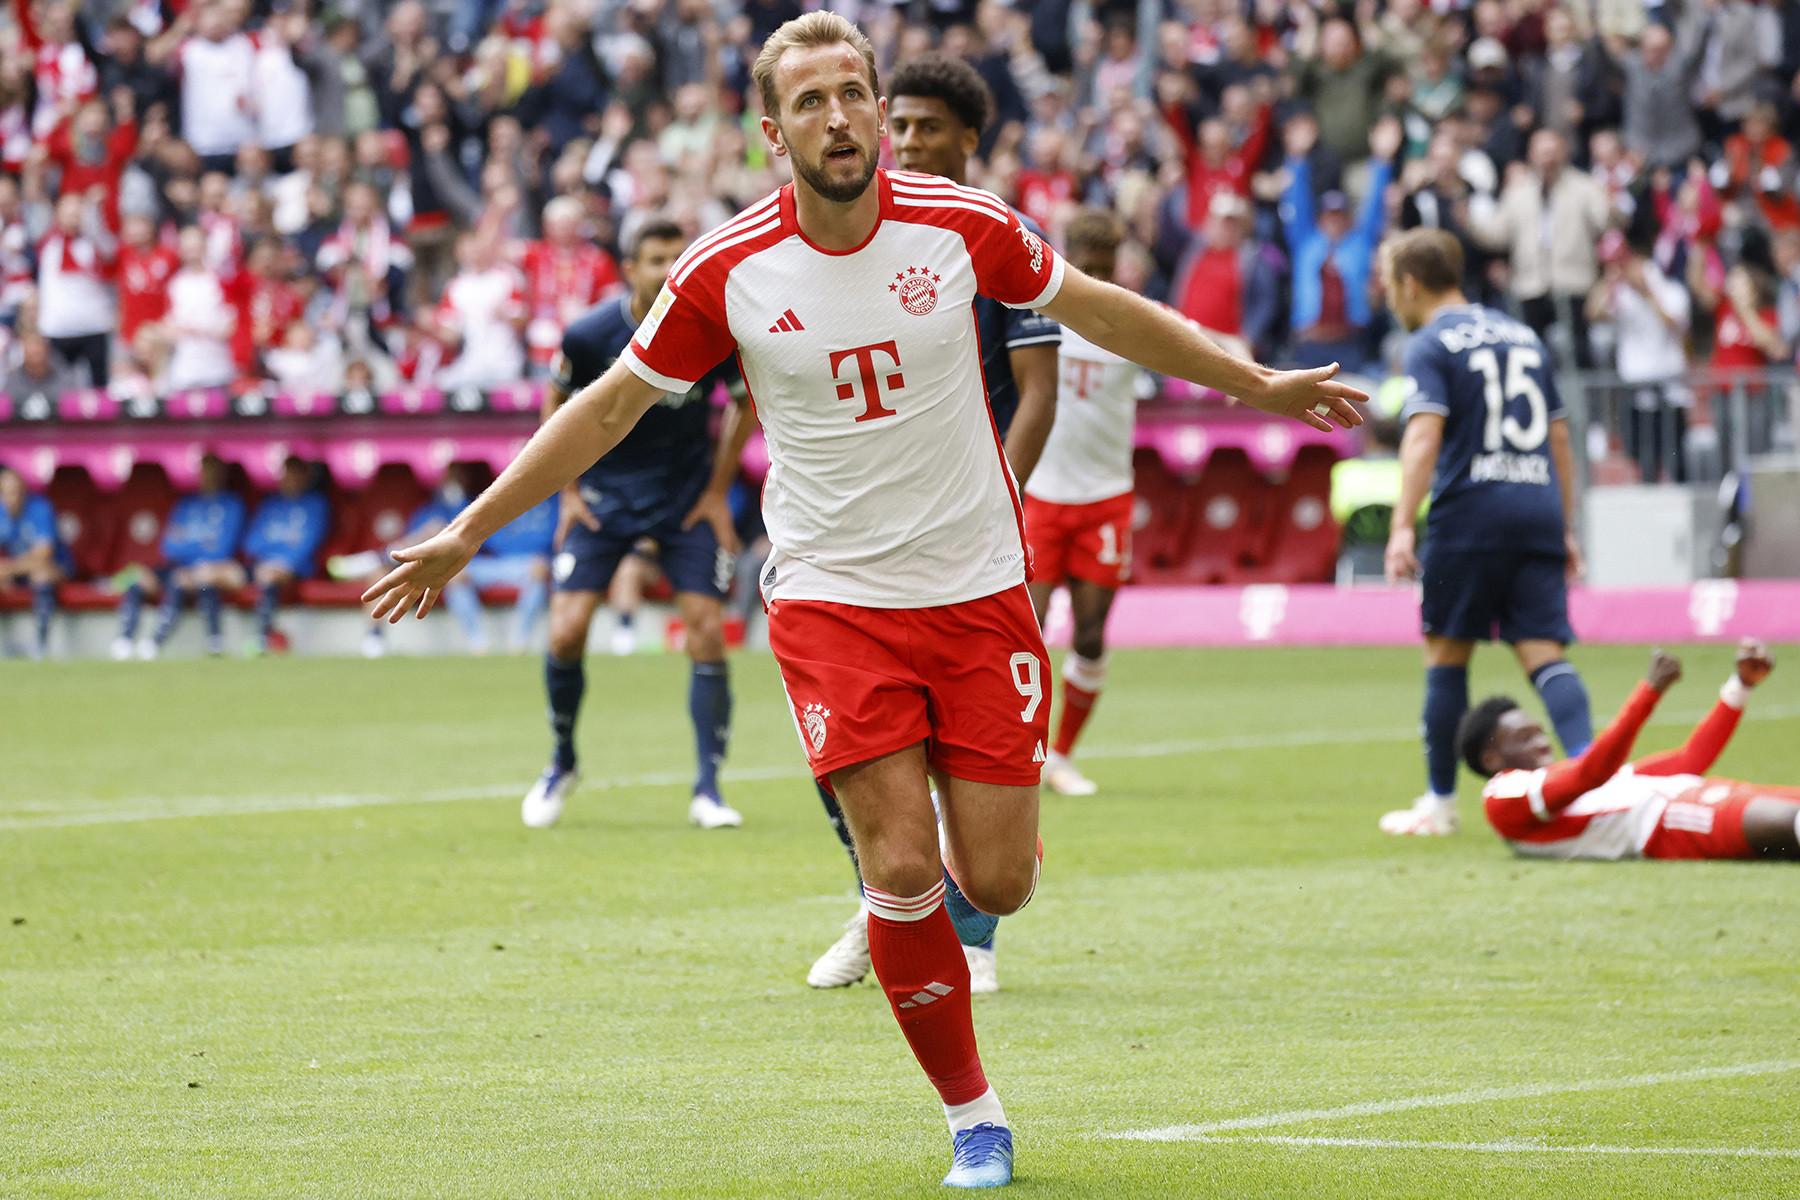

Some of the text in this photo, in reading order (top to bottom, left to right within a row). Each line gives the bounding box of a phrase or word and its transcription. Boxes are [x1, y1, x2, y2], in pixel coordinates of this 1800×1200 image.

[907, 278, 934, 292] BAYERN
[829, 340, 905, 423] T
[1468, 346, 1548, 452] 15
[1010, 651, 1042, 722] 9
